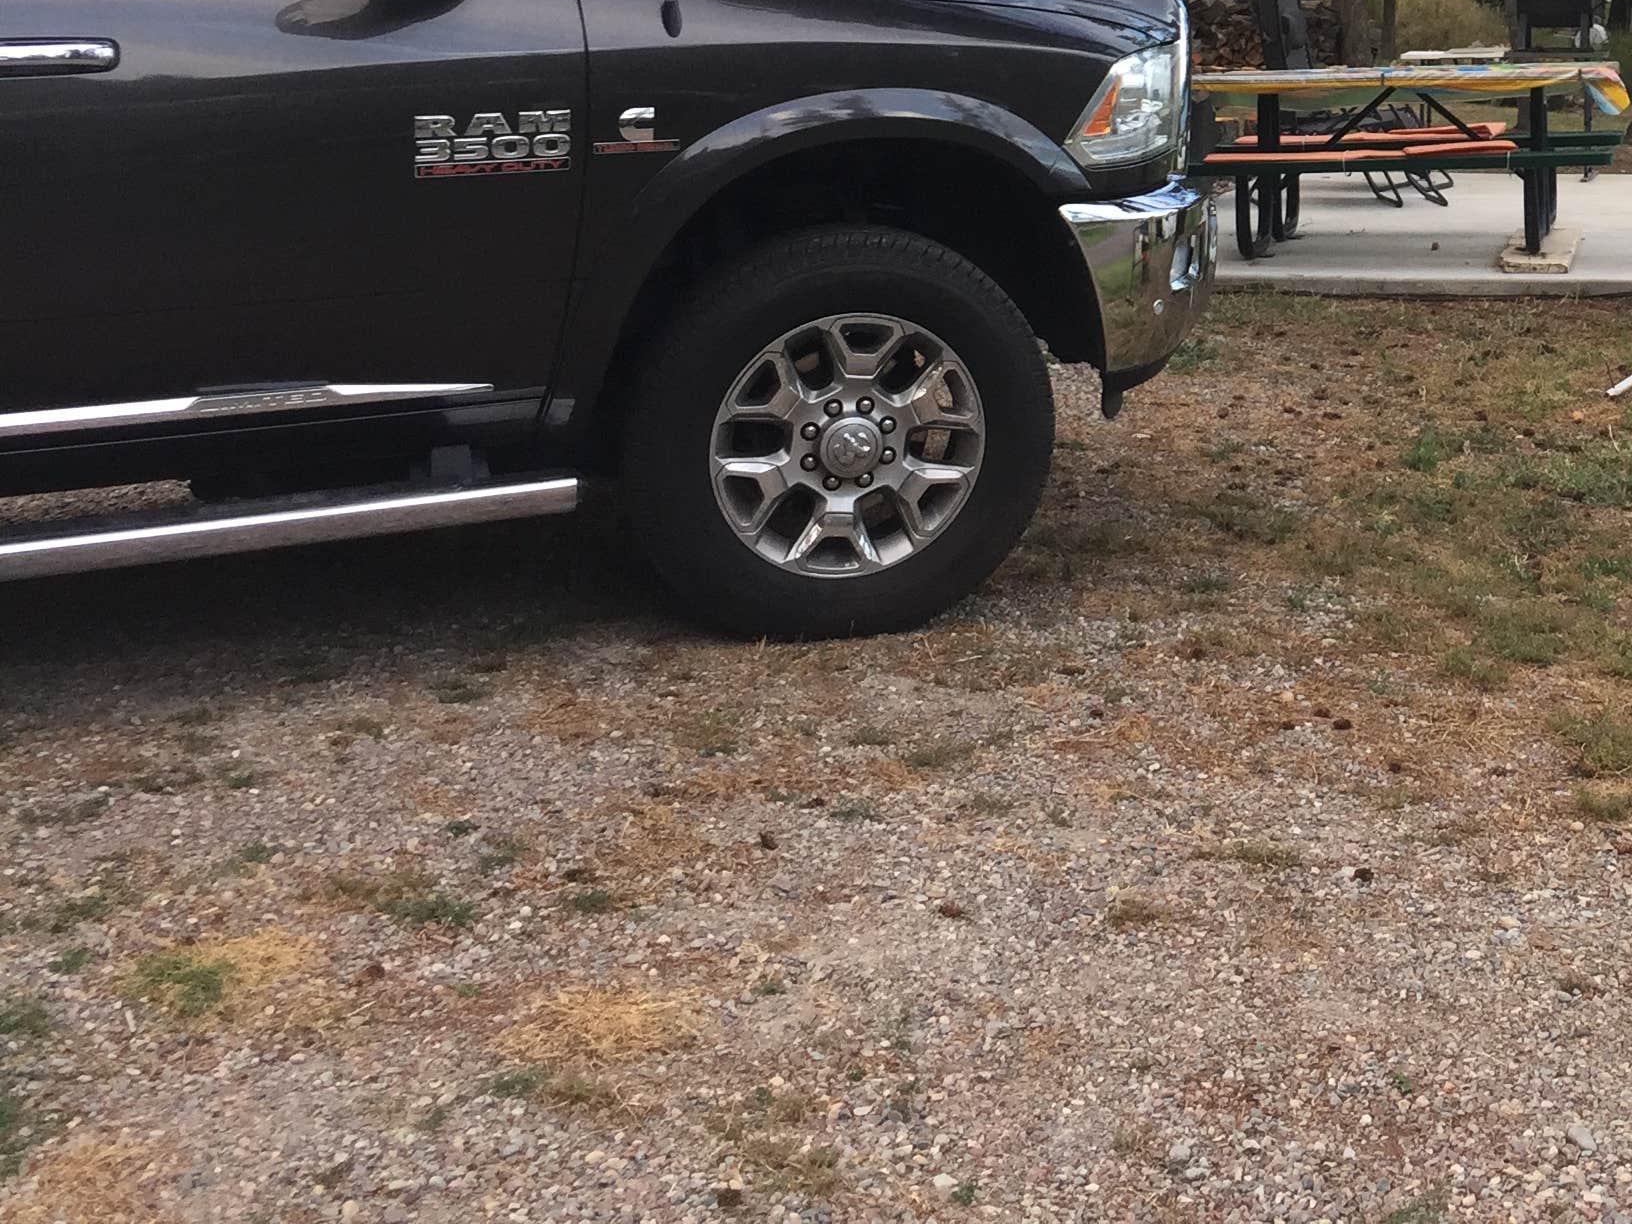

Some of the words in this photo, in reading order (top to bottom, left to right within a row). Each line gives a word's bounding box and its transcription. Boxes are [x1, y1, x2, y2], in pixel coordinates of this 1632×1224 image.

[414, 109, 571, 137] RAM
[415, 134, 571, 162] 3500
[419, 163, 498, 176] HEAVY
[502, 160, 565, 172] DUTY
